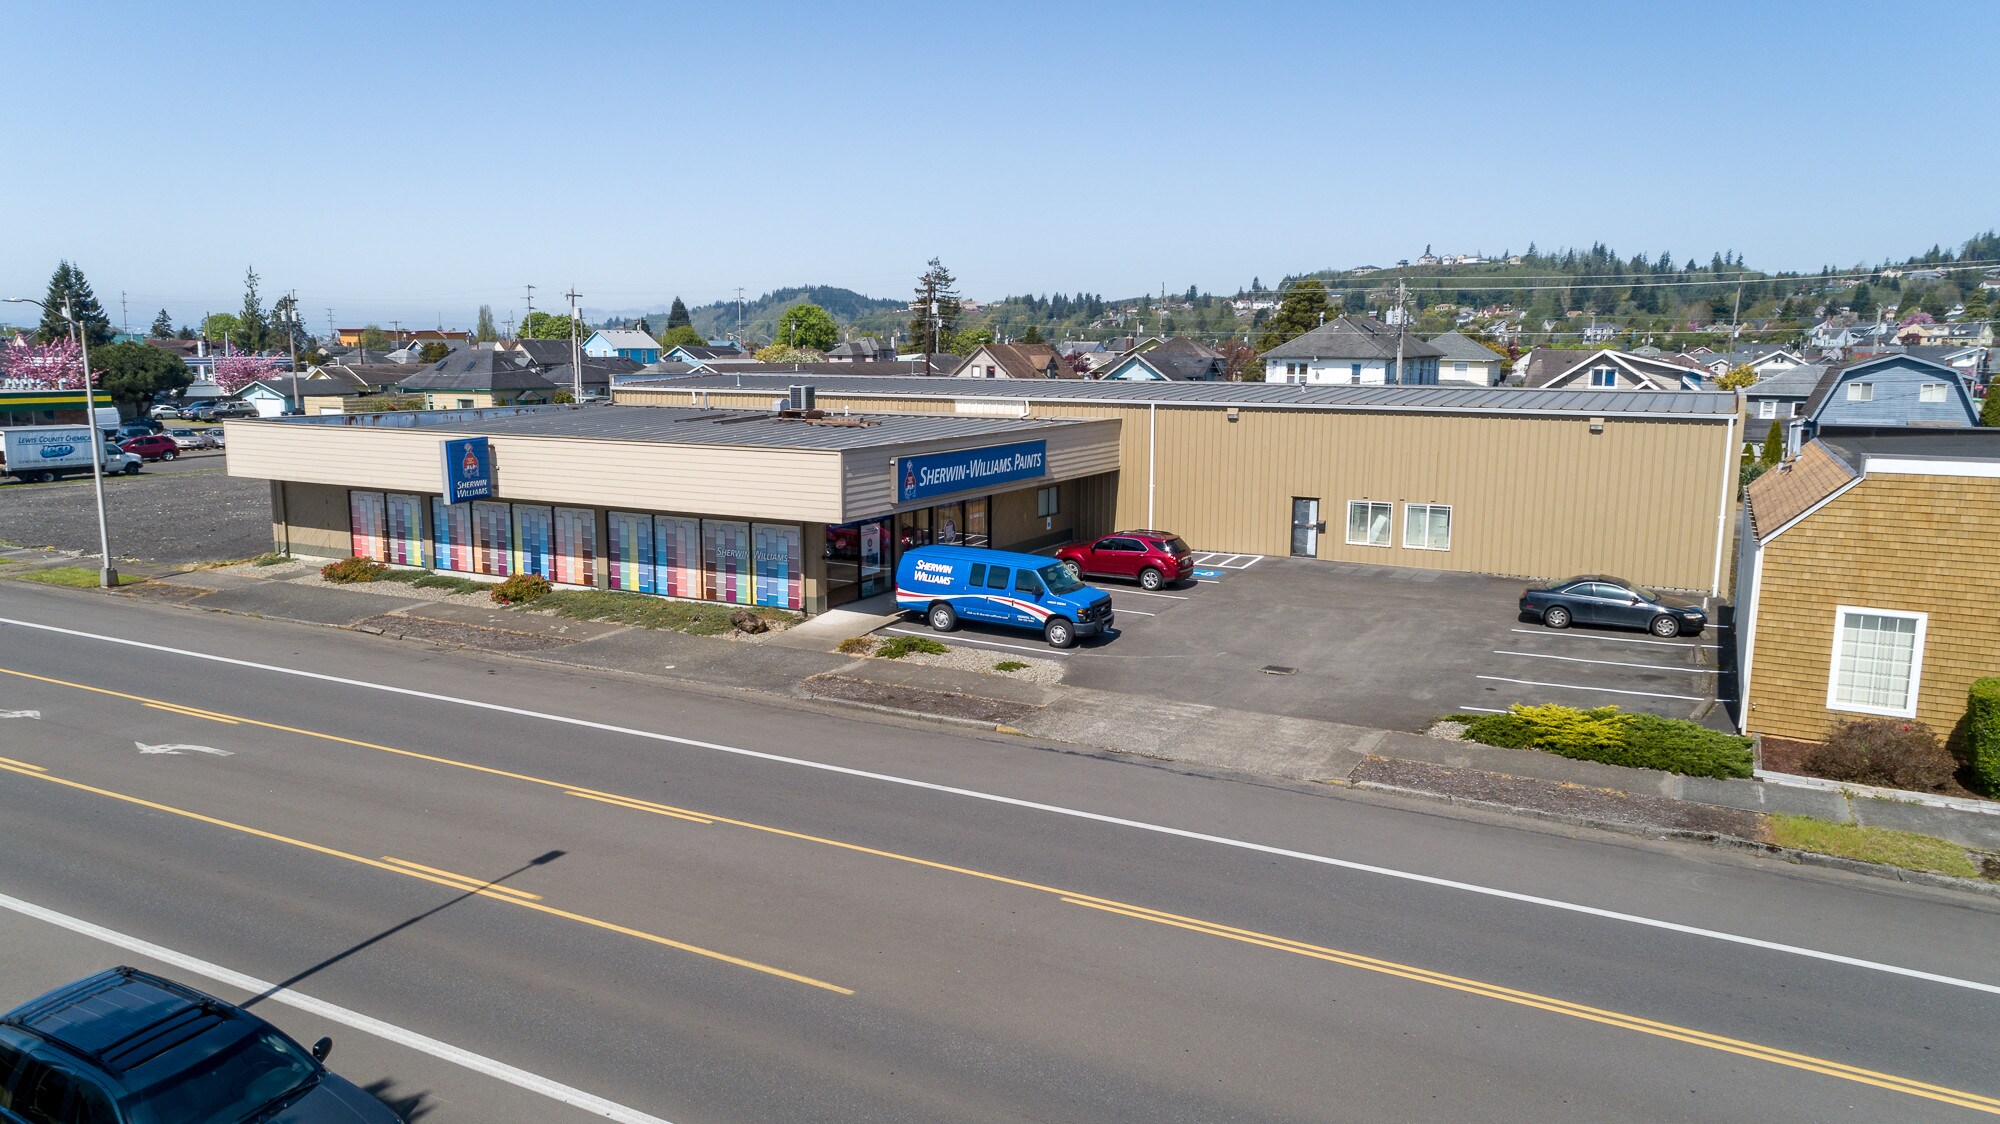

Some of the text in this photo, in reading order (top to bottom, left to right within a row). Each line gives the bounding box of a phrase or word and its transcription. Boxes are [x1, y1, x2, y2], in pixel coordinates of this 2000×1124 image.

[18, 434, 92, 444] LEWIS COUNTY CHEMICA
[1013, 452, 1042, 471] PAINTS
[457, 479, 487, 490] SHERWIN
[457, 488, 488, 498] WILLIAMS
[717, 547, 788, 562] SHERWIN WILLIAMS
[915, 560, 953, 574] SHERWIN
[914, 570, 952, 586] WILLIAMS
